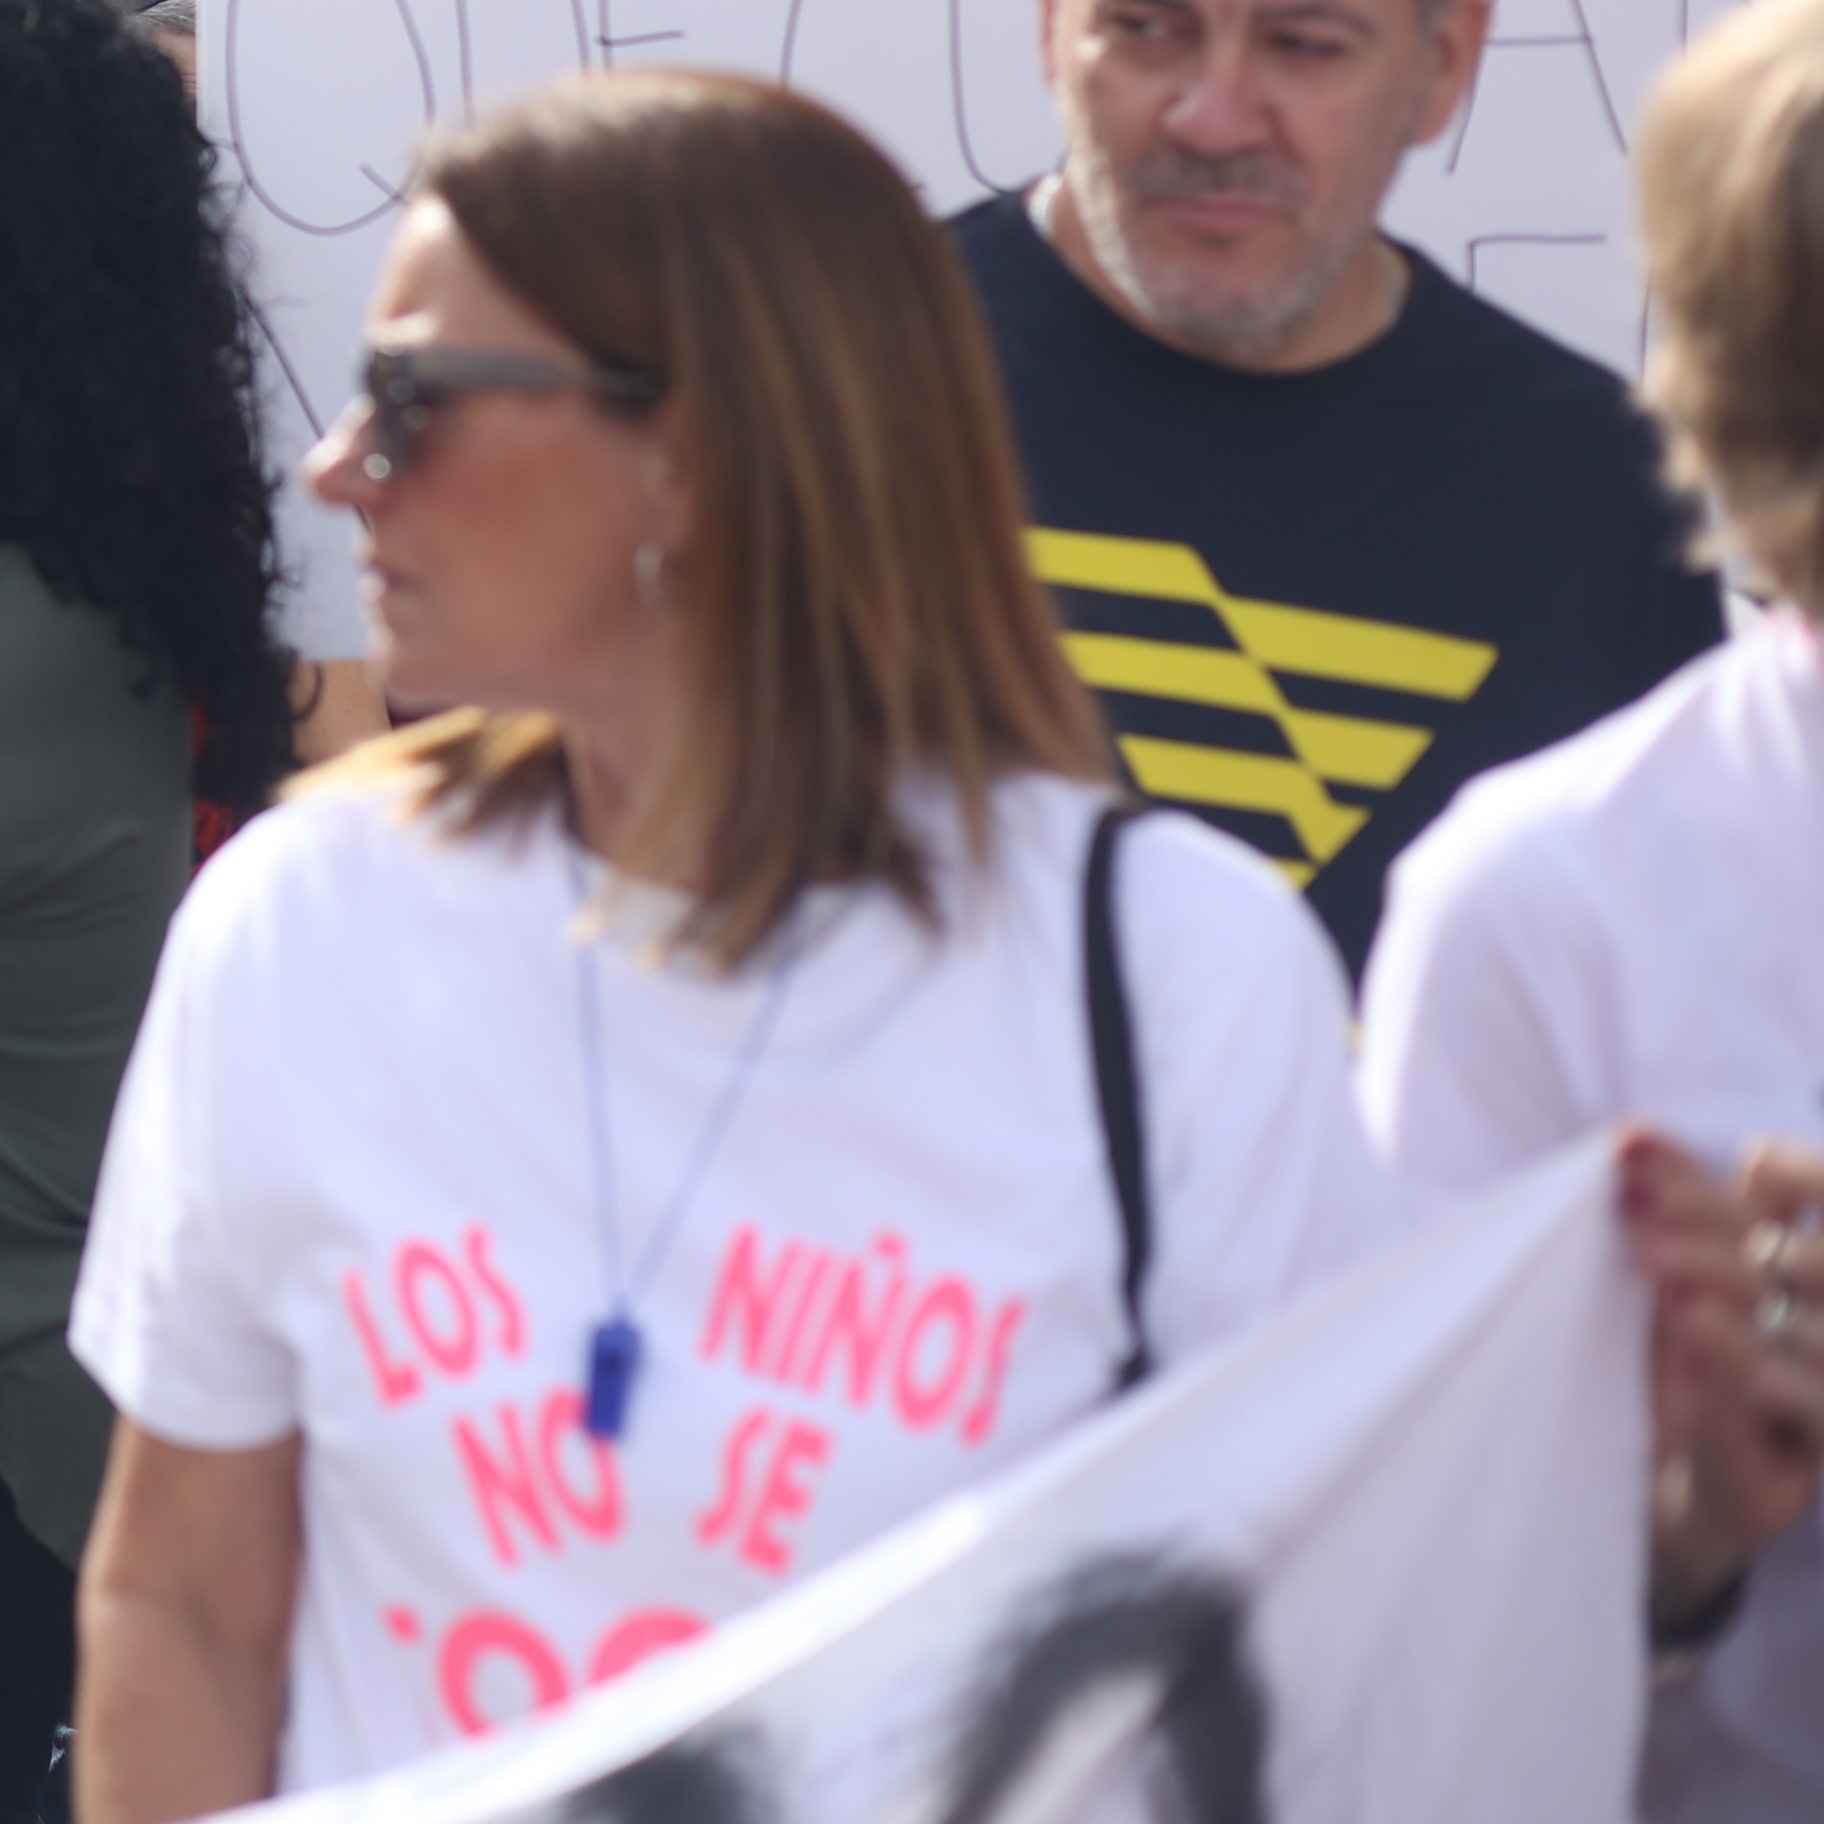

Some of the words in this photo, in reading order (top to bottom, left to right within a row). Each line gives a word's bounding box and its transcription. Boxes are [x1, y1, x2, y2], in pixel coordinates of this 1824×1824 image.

[344, 1223, 528, 1409] LOS
[697, 1221, 1029, 1448] NIÑOS
[451, 1388, 626, 1570] NO
[694, 1406, 836, 1573] SE
